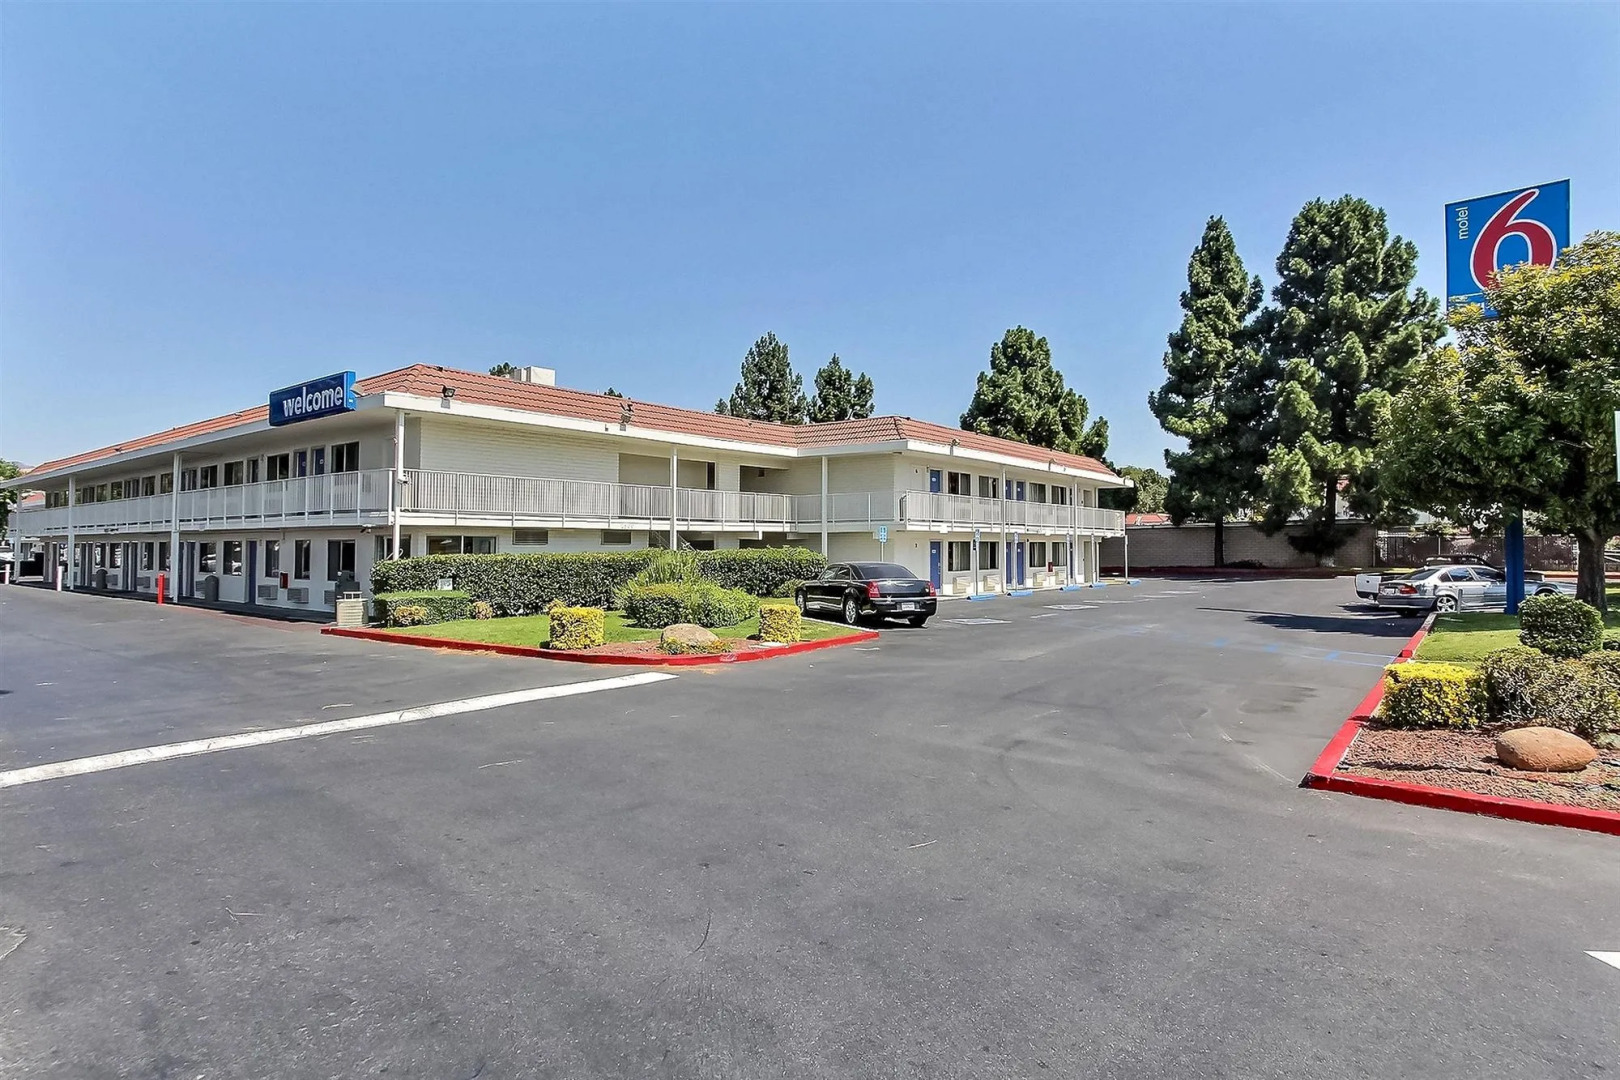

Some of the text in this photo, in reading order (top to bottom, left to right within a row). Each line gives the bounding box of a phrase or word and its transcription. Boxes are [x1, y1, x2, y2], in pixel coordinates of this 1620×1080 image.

[1456, 206, 1469, 240] motel
[1470, 188, 1557, 291] 6
[283, 386, 343, 417] welcome
